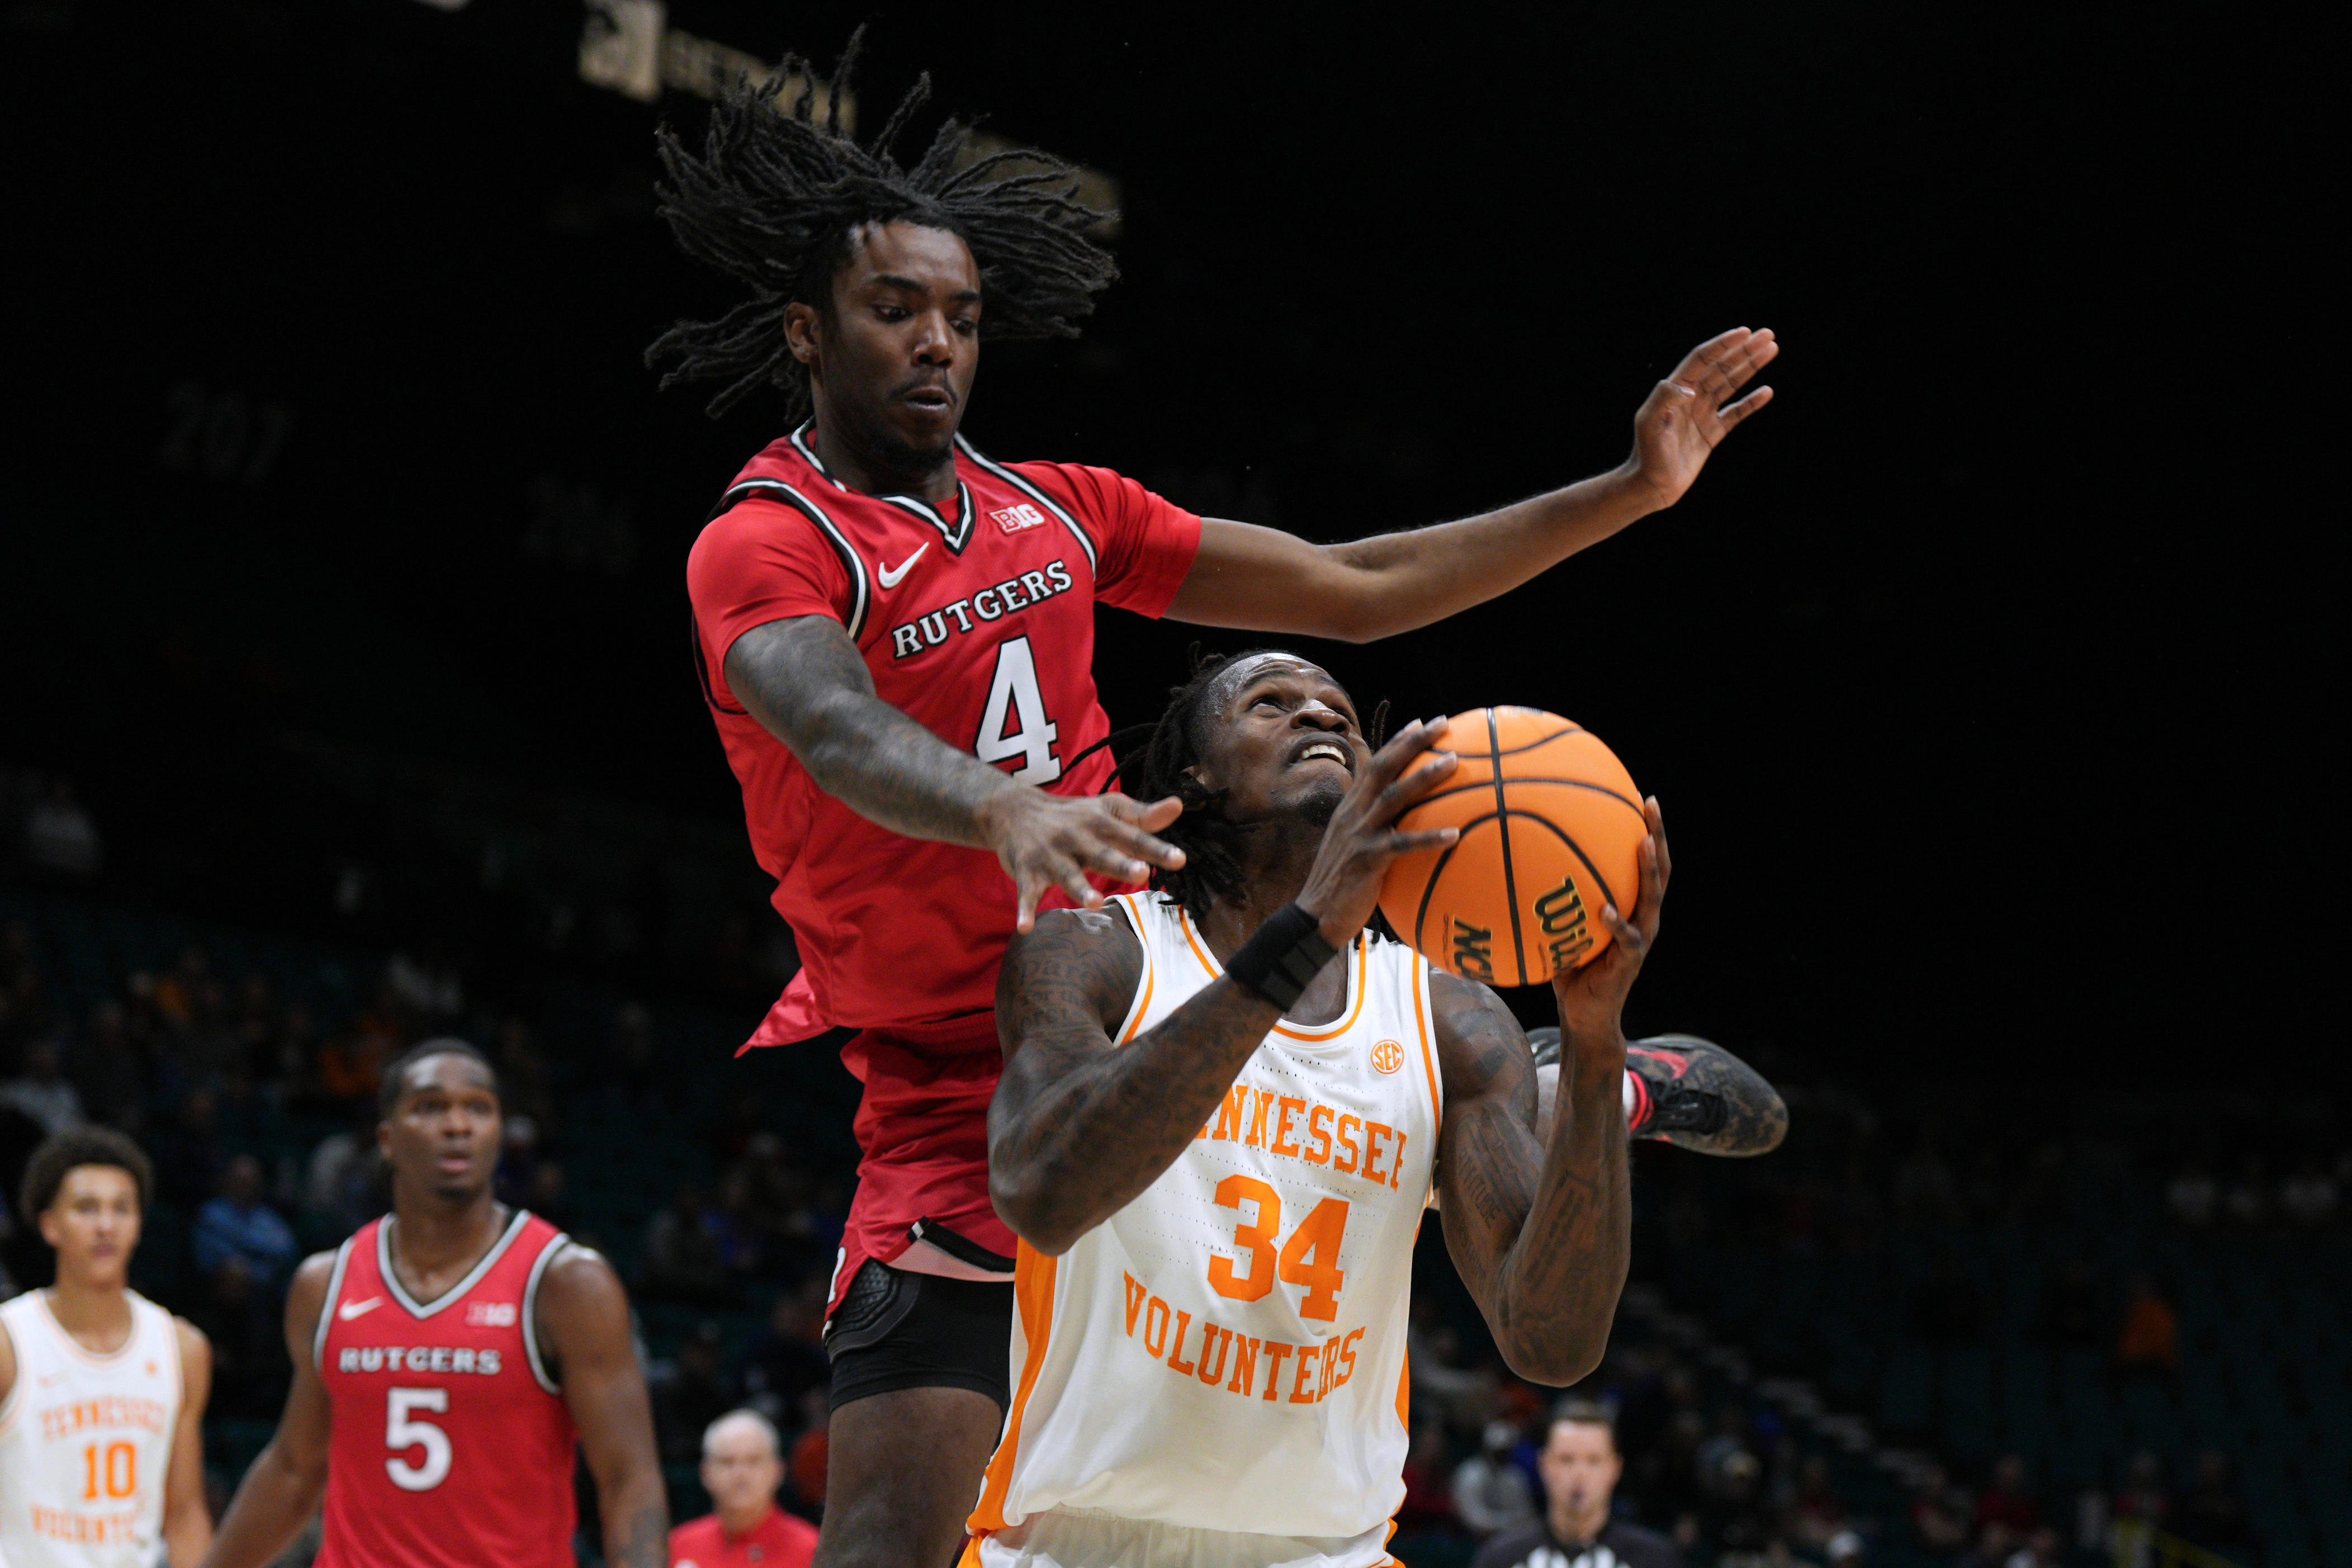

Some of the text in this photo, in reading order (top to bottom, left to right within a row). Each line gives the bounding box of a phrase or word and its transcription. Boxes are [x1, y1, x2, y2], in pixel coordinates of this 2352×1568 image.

[893, 559, 1073, 659] RUTGERS
[974, 633, 1061, 786] 4
[1452, 915, 1496, 984] NC
[1533, 873, 1594, 972] Wil
[1373, 1043, 1401, 1070] SEC
[1195, 1085, 1407, 1193] NNESSE
[1208, 1174, 1350, 1322] 34
[339, 1347, 501, 1375] RUTGERS
[83, 1440, 136, 1501] 10
[385, 1386, 452, 1492] 5
